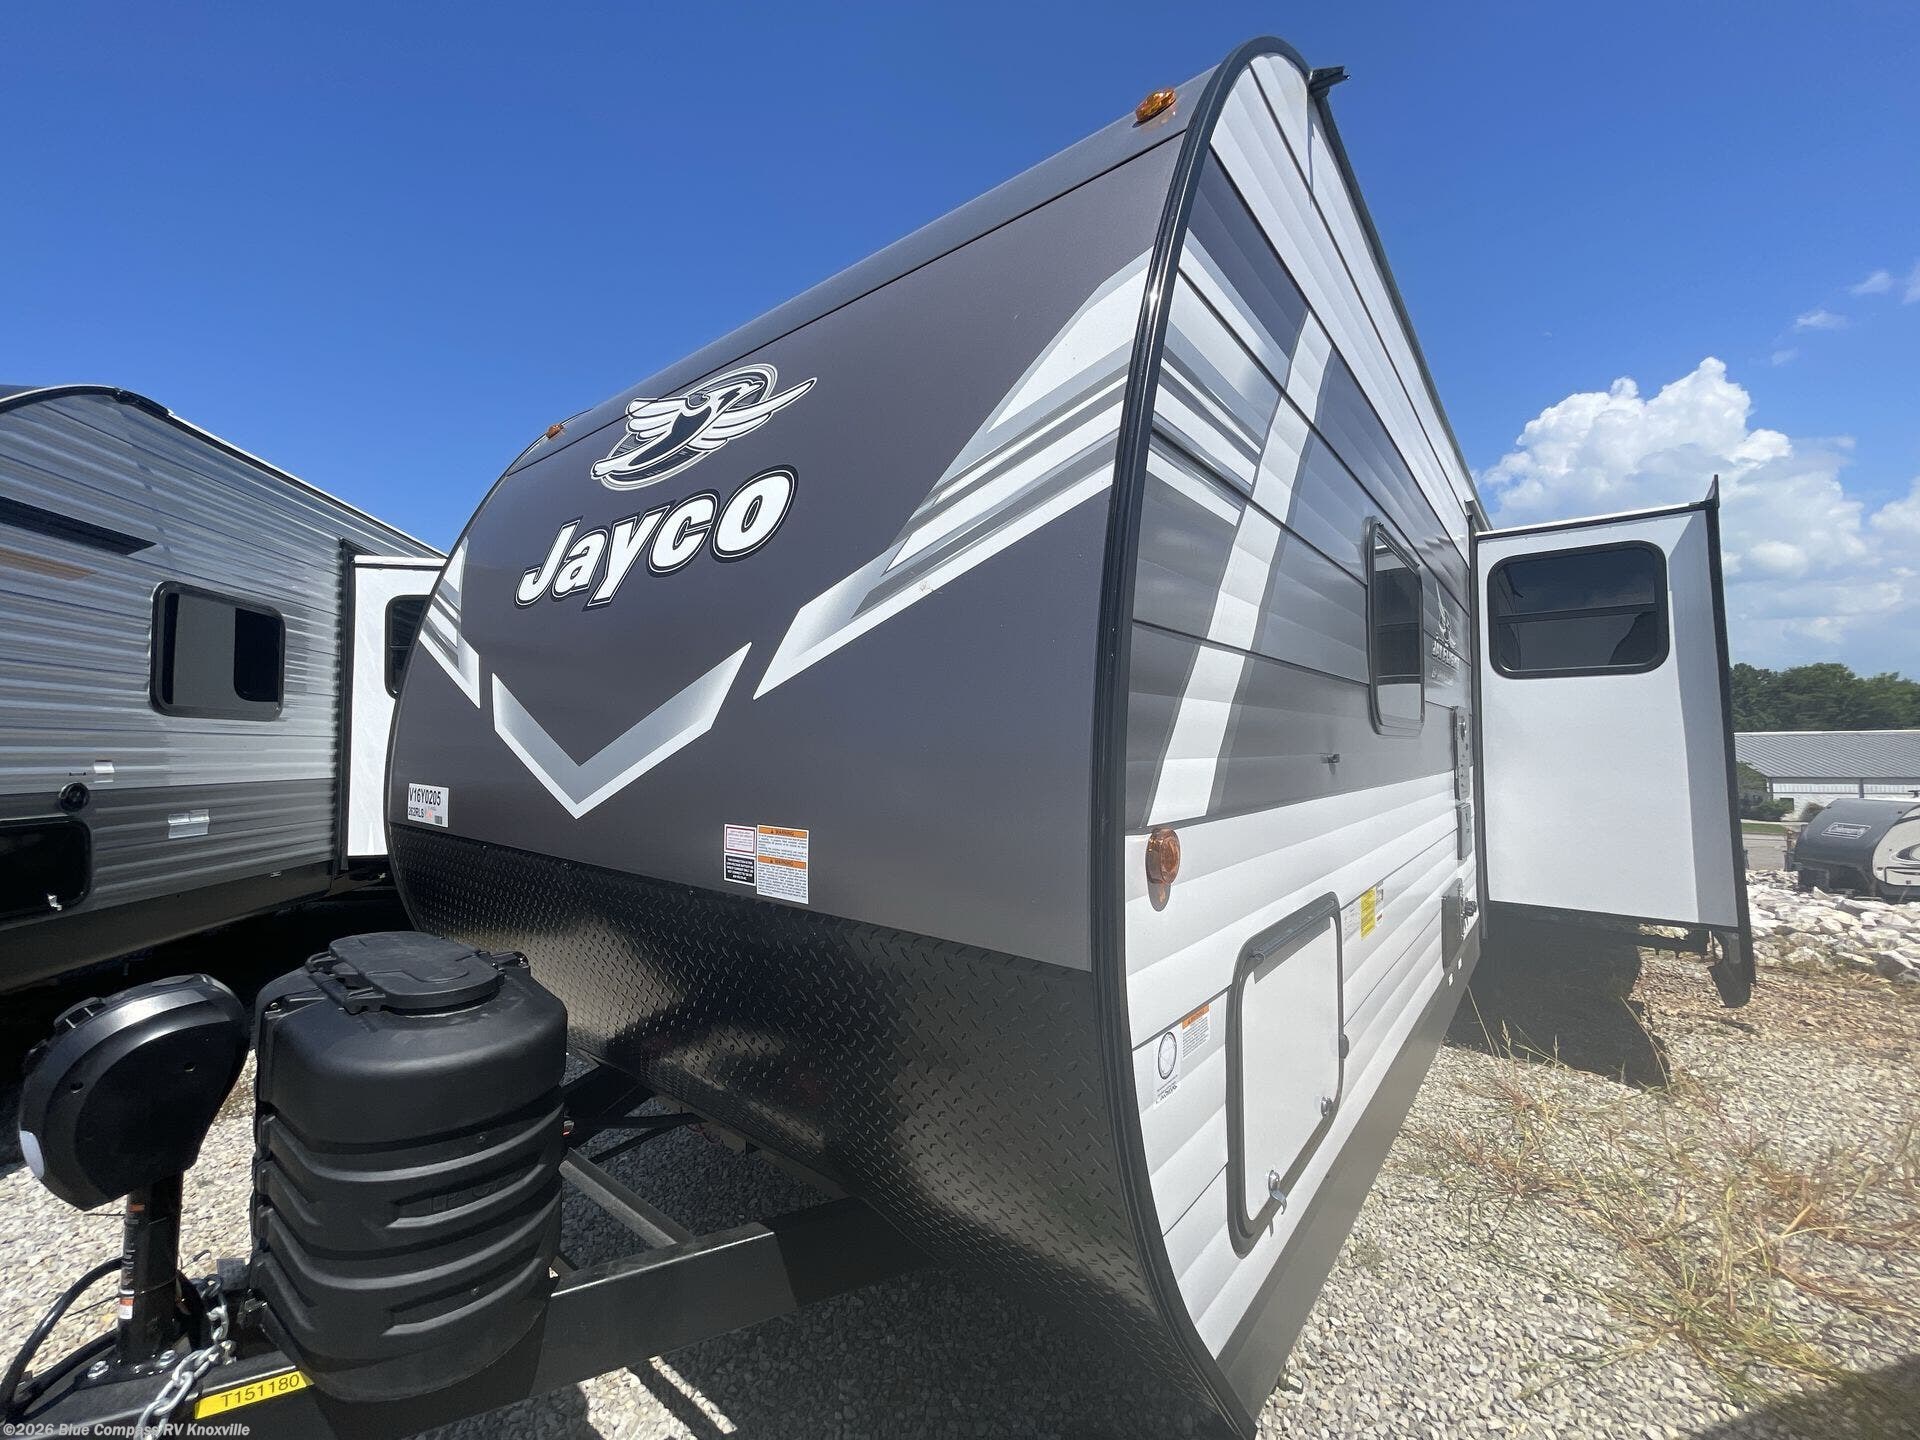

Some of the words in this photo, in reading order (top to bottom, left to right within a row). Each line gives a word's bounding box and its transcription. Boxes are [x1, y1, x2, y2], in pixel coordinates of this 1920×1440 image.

[514, 467, 797, 609] Jayco
[409, 787, 441, 806] V16Y0205
[220, 1374, 300, 1407] T151180
